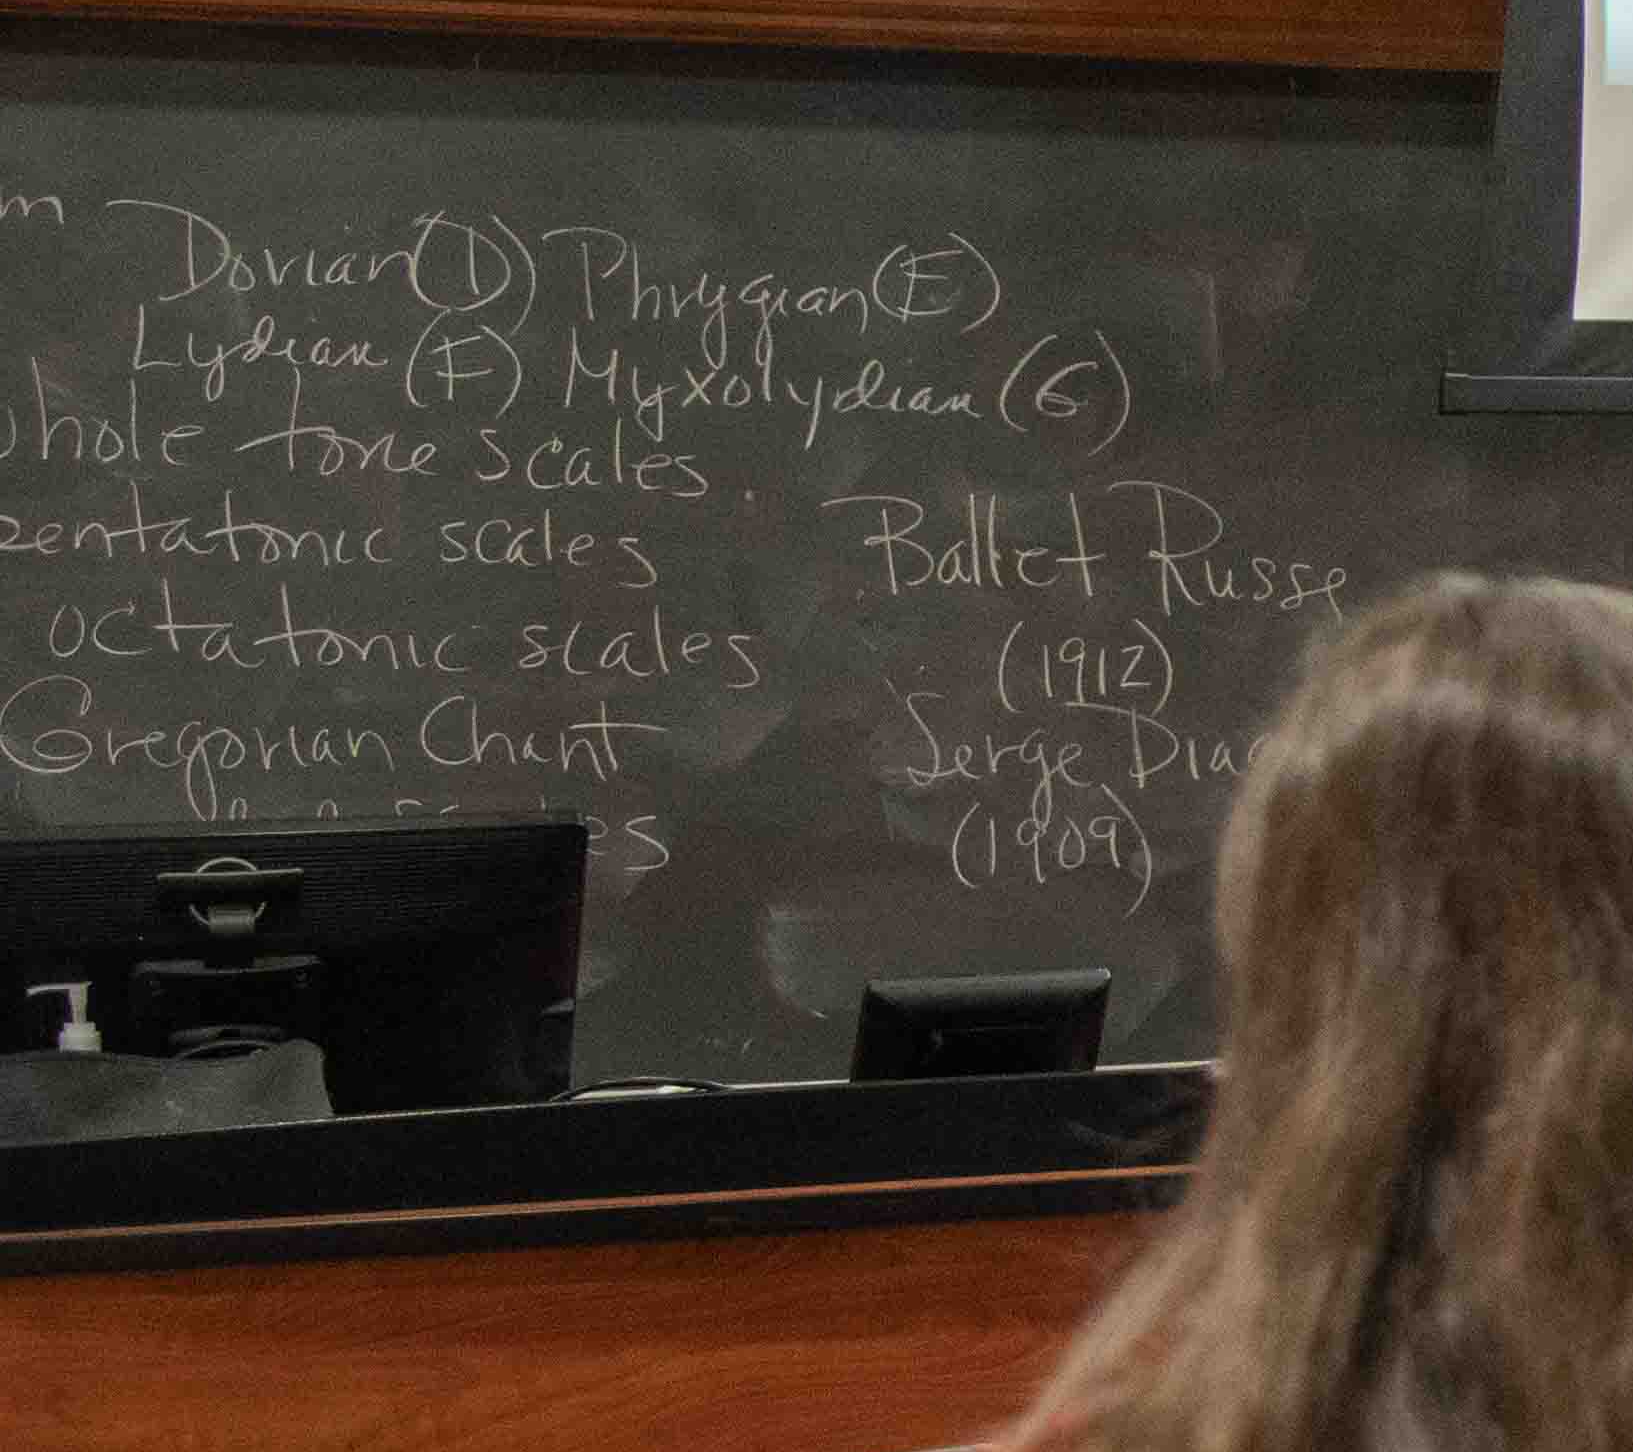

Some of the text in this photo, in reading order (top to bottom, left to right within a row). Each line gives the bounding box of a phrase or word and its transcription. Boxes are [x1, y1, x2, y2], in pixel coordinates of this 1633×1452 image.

[131, 303, 388, 402] Lydian
[236, 367, 438, 476] tone
[476, 417, 709, 498] scales
[440, 508, 657, 589] scales
[821, 494, 1106, 597] Ballet
[519, 604, 760, 689] scales
[997, 619, 1173, 714] (1912)
[0, 674, 669, 823] Gregorian Chant
[952, 783, 1153, 919] (1909)
